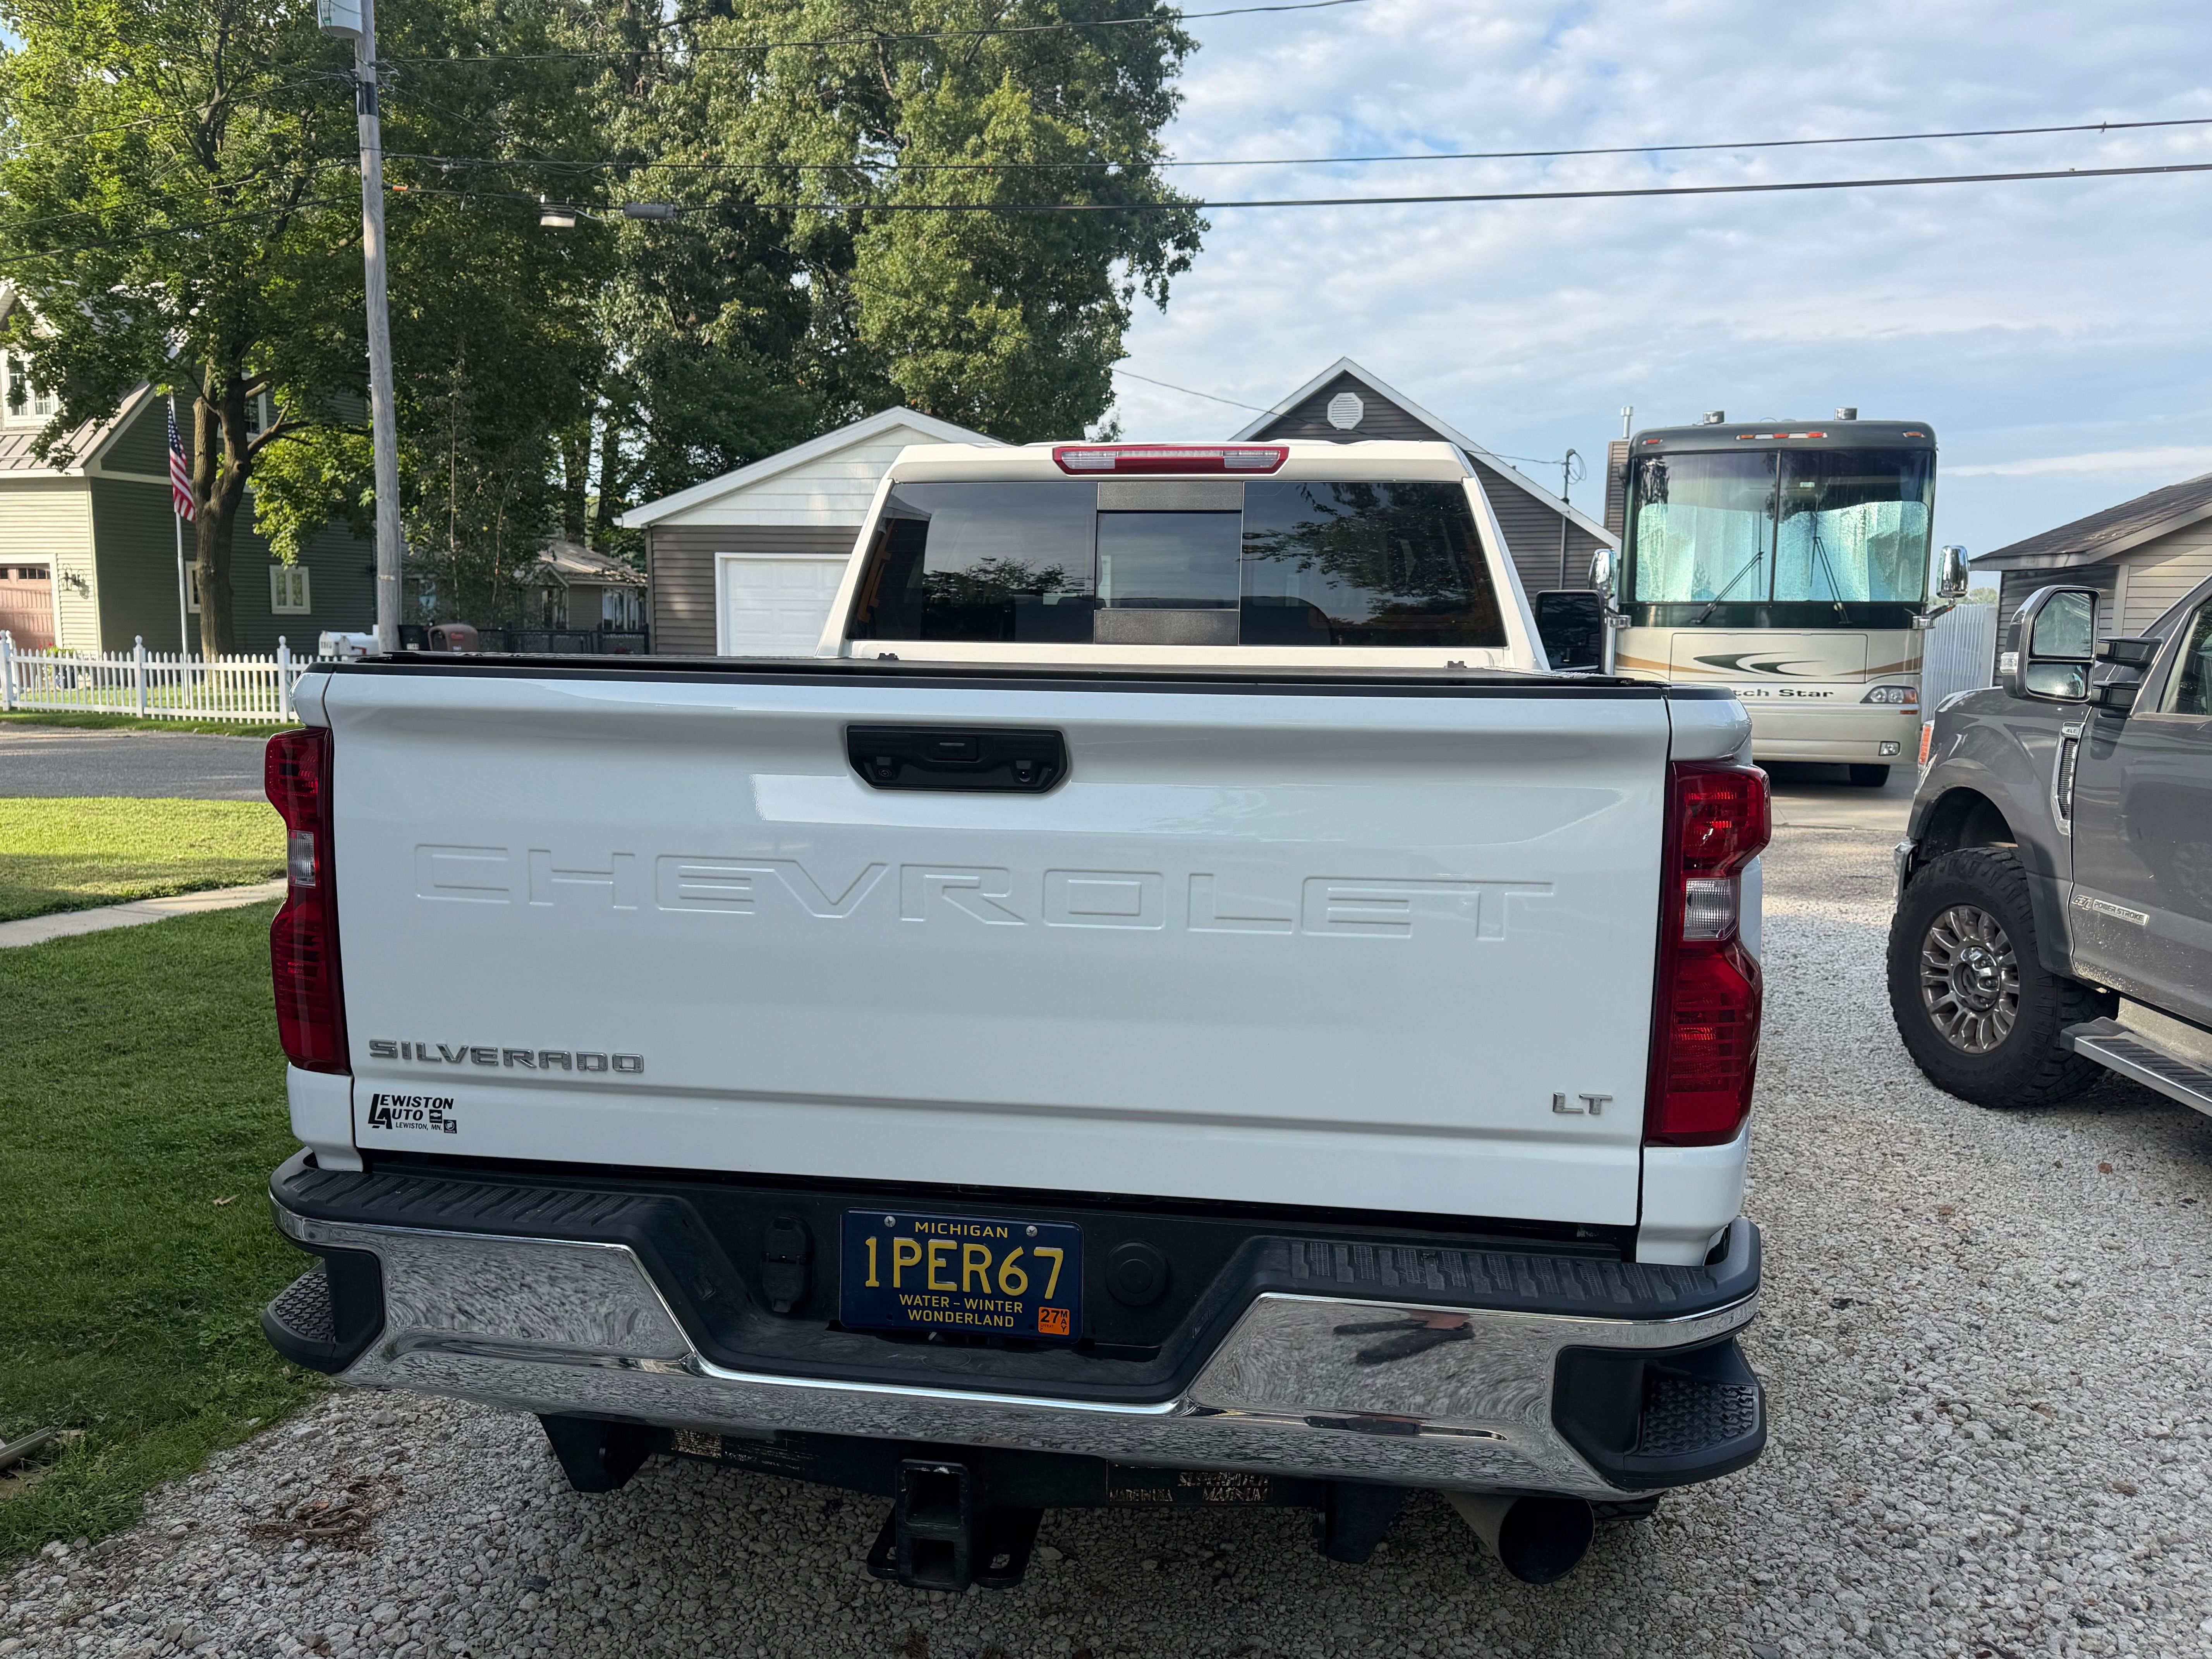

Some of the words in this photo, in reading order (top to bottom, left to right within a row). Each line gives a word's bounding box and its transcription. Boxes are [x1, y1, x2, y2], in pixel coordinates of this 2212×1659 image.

[1779, 689, 1834, 697] Star
[415, 844, 1554, 941] CHEVROLET
[2094, 901, 2116, 913] POWER
[2116, 908, 2144, 921] STROKE
[369, 1038, 644, 1072] SILVERADO
[368, 1094, 454, 1125] LEWISTON
[1553, 1092, 1613, 1115] LT
[376, 1108, 423, 1129] AUTO
[396, 1122, 428, 1131] LEWISTON,
[915, 1222, 1008, 1238] MICHIGAN
[866, 1237, 1063, 1299] 1PER67
[899, 1294, 949, 1308] WATER
[964, 1298, 1023, 1314] WINTER
[908, 1309, 1014, 1328] WONDERLAND
[1041, 1309, 1060, 1323] 27
[1202, 1487, 1267, 1501] MAGNUM
